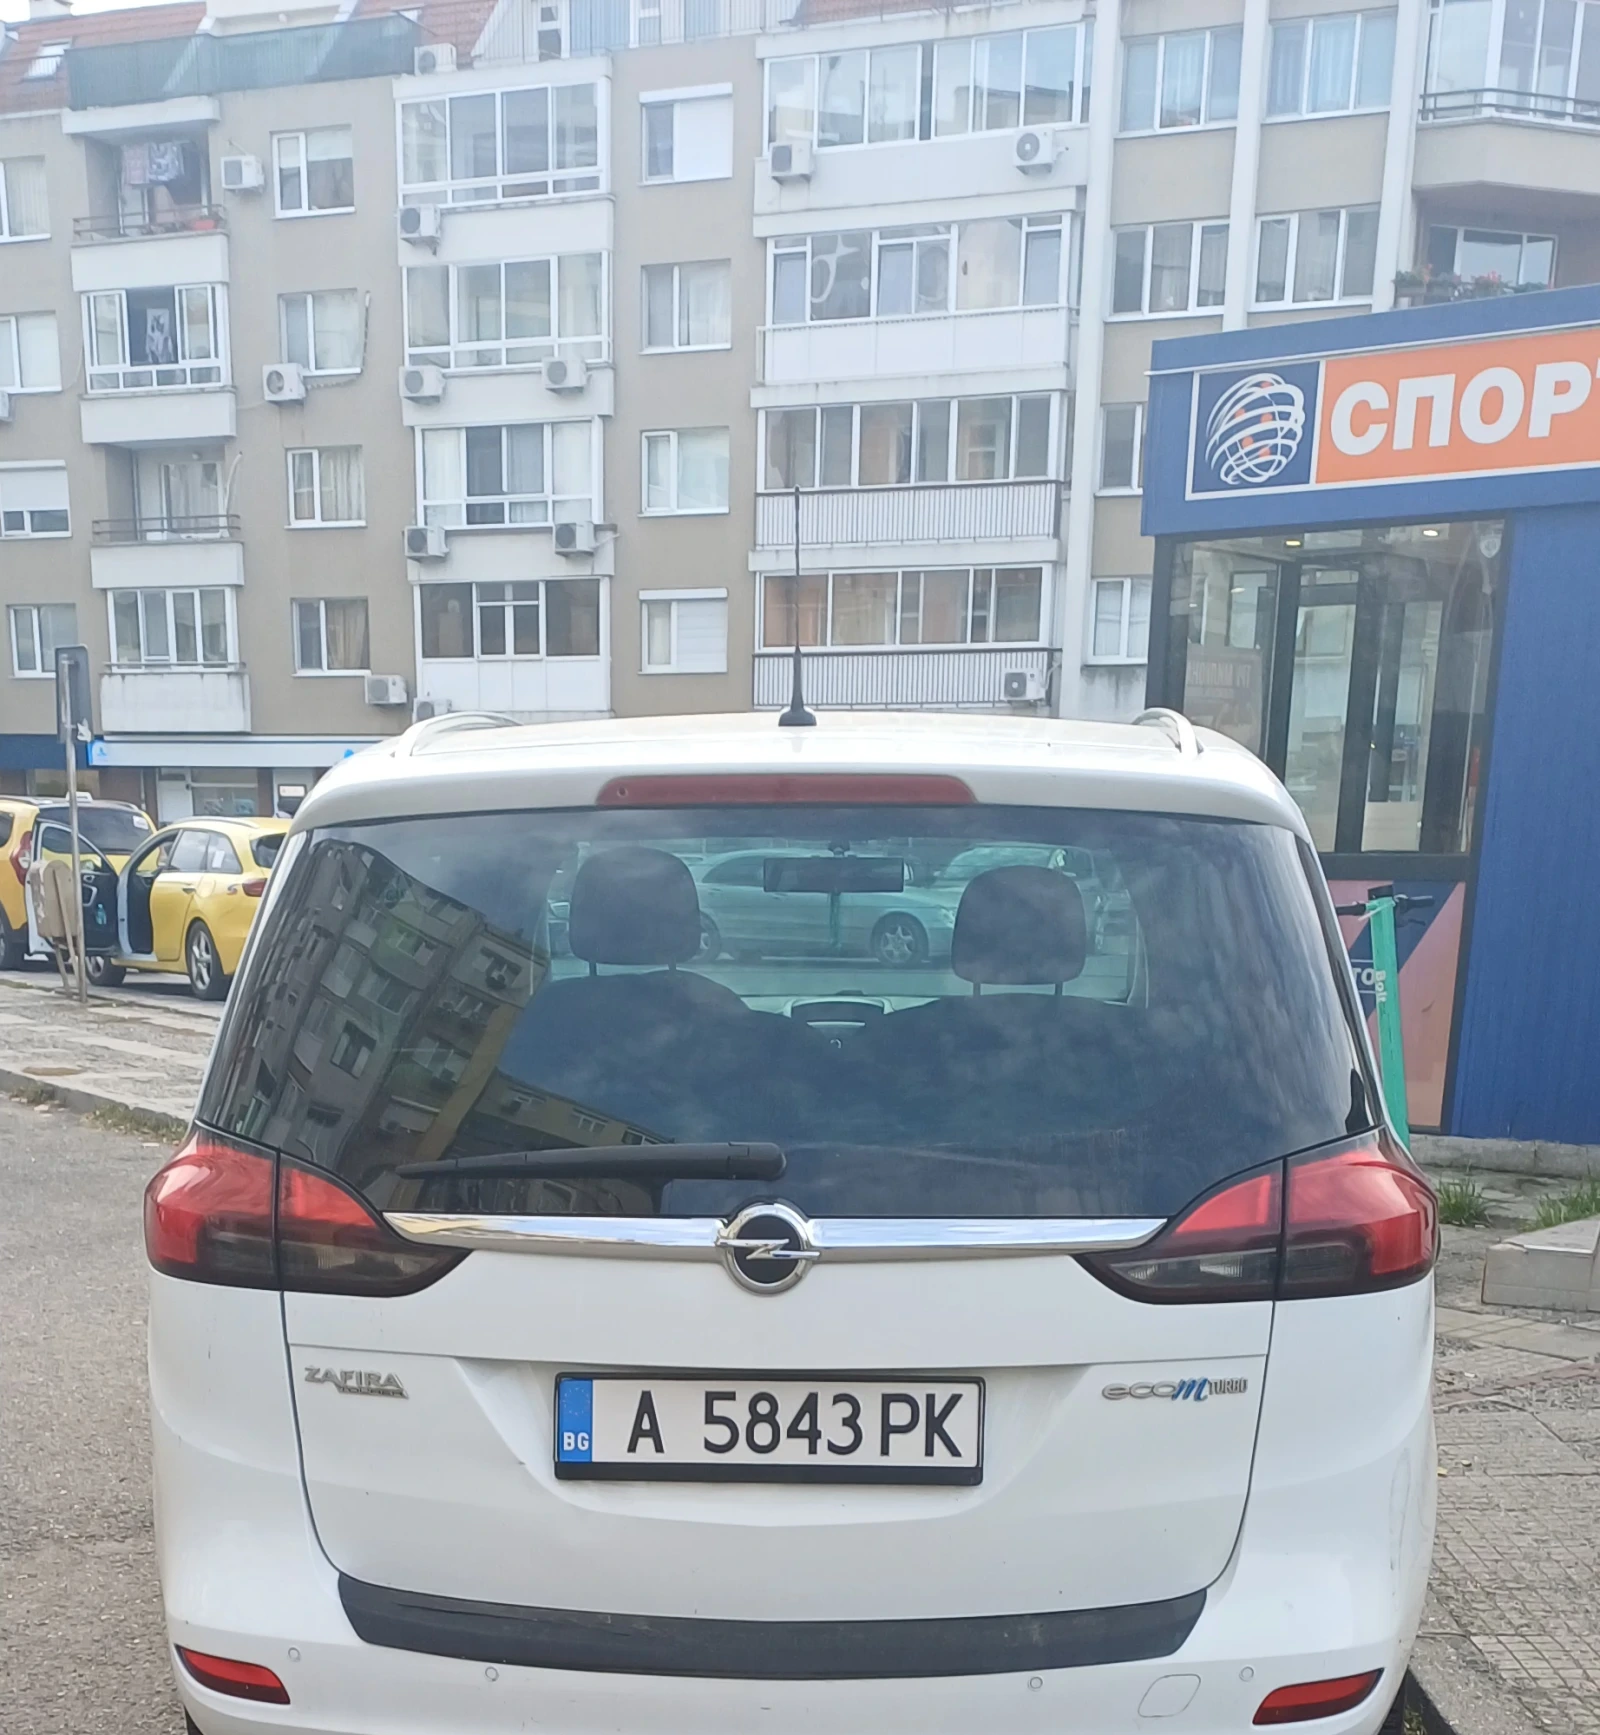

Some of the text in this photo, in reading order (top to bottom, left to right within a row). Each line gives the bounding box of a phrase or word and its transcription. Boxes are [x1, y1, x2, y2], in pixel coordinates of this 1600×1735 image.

[1331, 357, 1600, 456] СПОР
[1375, 969, 1388, 1003] Bolt
[304, 1366, 405, 1390] ZAFIRA
[626, 1389, 964, 1458] A 5843 PK
[563, 1431, 590, 1451] BG
